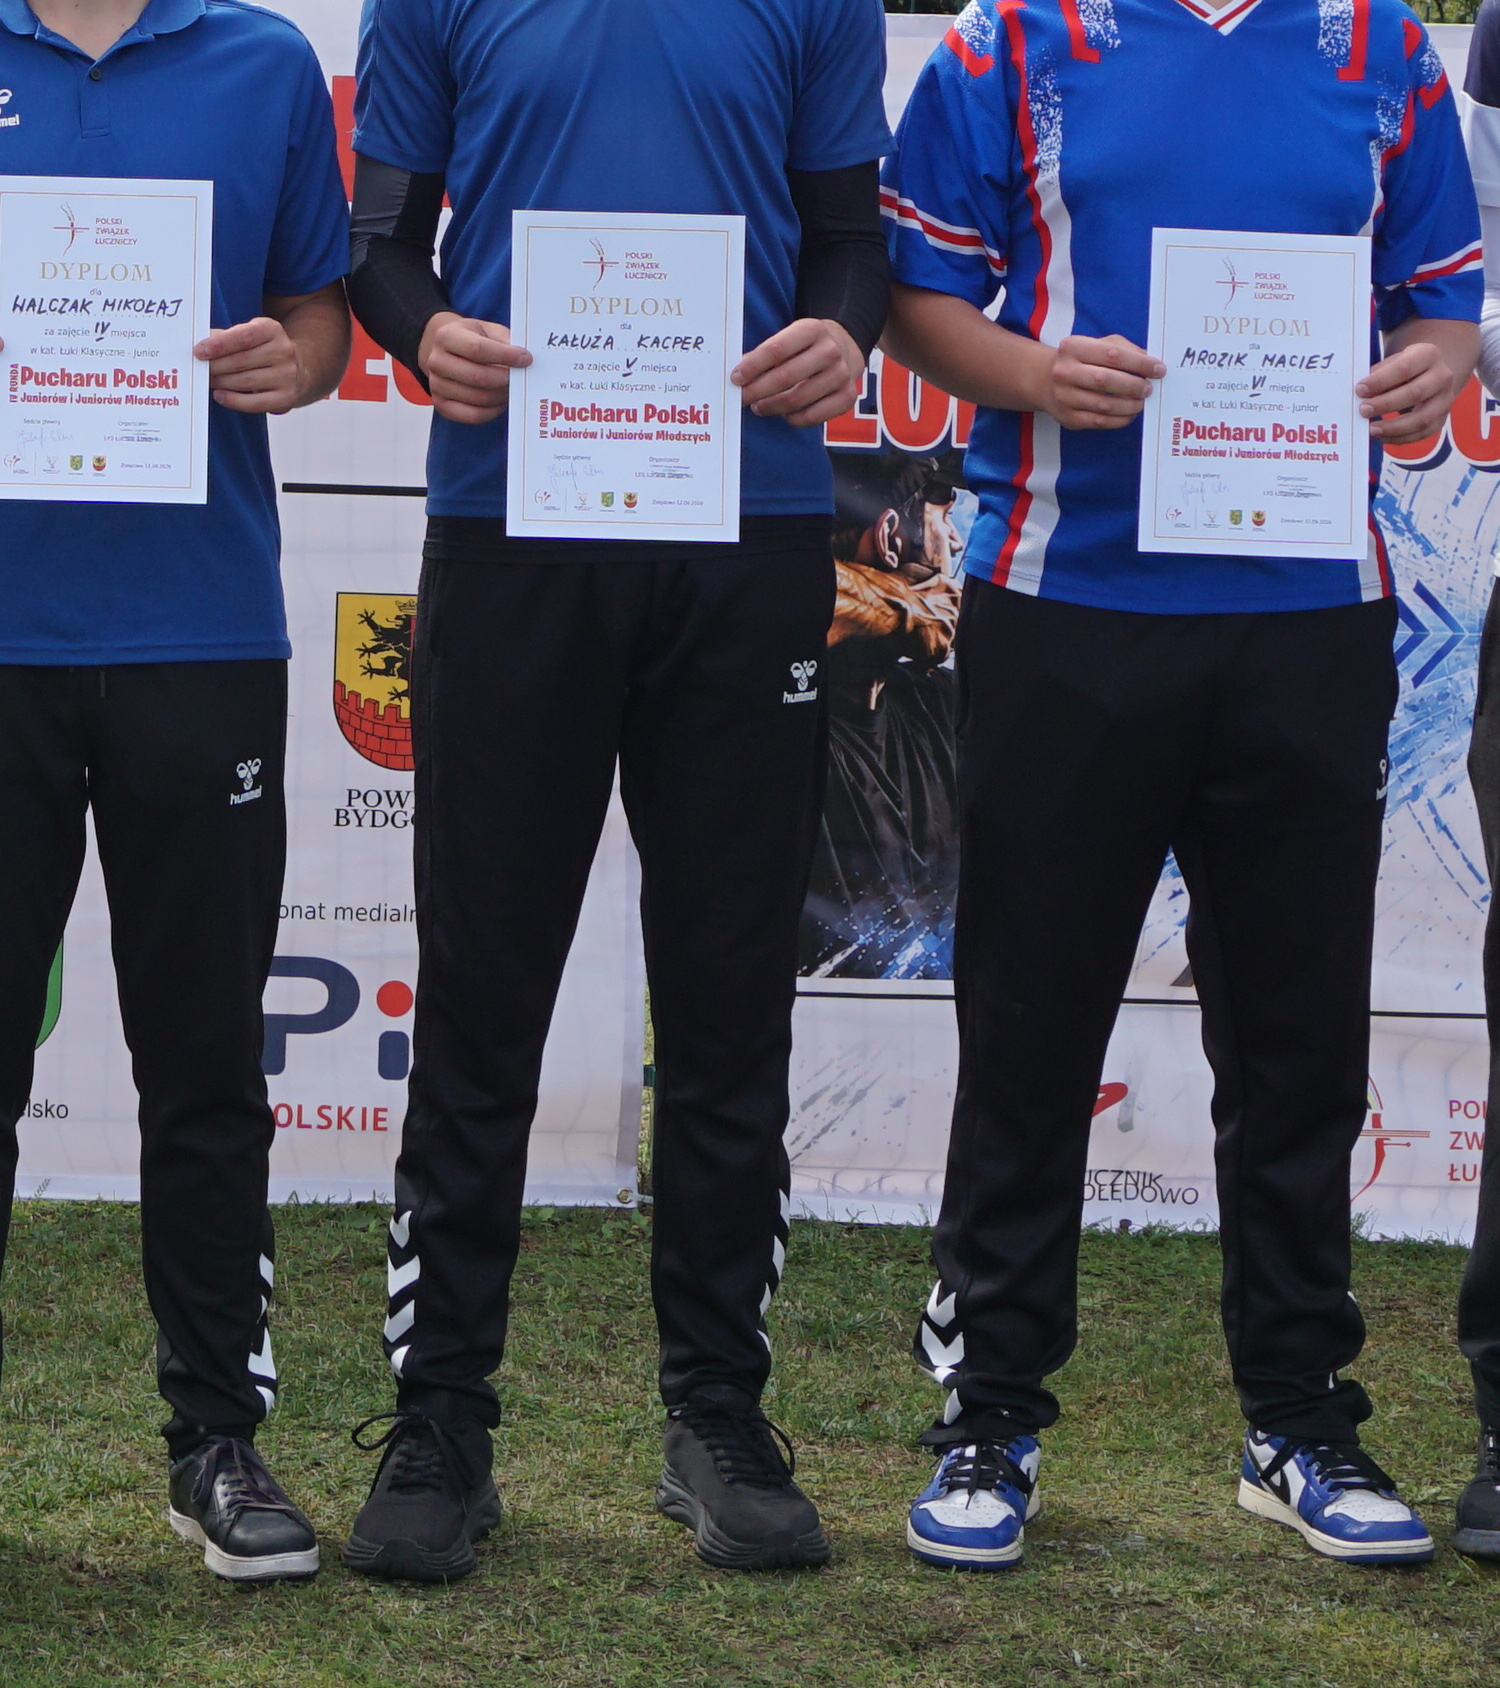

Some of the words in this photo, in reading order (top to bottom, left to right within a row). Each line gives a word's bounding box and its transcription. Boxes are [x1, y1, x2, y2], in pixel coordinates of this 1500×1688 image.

[625, 252, 653, 260] POLSKI
[40, 262, 154, 282] DYPLOM
[12, 295, 94, 315] WALCZAK
[102, 297, 184, 318] MIKOŁAJ
[570, 296, 684, 317] DYPLOM
[57, 327, 90, 340] zajęcie
[111, 329, 147, 341] miejsca
[1203, 315, 1311, 337] DYPLOM
[547, 328, 615, 351] KAŁUŻA
[637, 334, 705, 351] KACPER
[573, 363, 584, 371] za
[586, 362, 620, 374] zajęcie
[641, 363, 677, 374] miejsca
[1180, 347, 1248, 368] MROZIK
[1261, 352, 1334, 370] MACIEJ
[20, 366, 107, 388] Pucharu
[113, 368, 179, 390] Polski
[569, 381, 587, 391] kat.
[589, 381, 609, 391] Łuki
[611, 382, 656, 394] Klasyczne
[664, 383, 691, 394] Junior
[20, 392, 67, 405] Juniorów
[69, 392, 74, 404] i
[75, 393, 122, 405] Juniorów
[125, 394, 180, 409] Młodszych
[551, 402, 637, 423] Pucharu
[644, 403, 710, 425] Polski
[551, 428, 598, 439] Juniorów
[600, 428, 605, 439] i
[606, 429, 653, 441] Juniorów
[656, 430, 711, 444] Młodszych
[1183, 419, 1266, 443] Pucharu
[1272, 423, 1338, 445] Polski
[1182, 445, 1227, 458] Juniorów
[1228, 446, 1233, 458] i
[1234, 446, 1282, 460] Juniorów
[1284, 449, 1339, 464] Młodszych
[230, 784, 263, 805] hummel
[272, 1102, 389, 1132] OLSKIE
